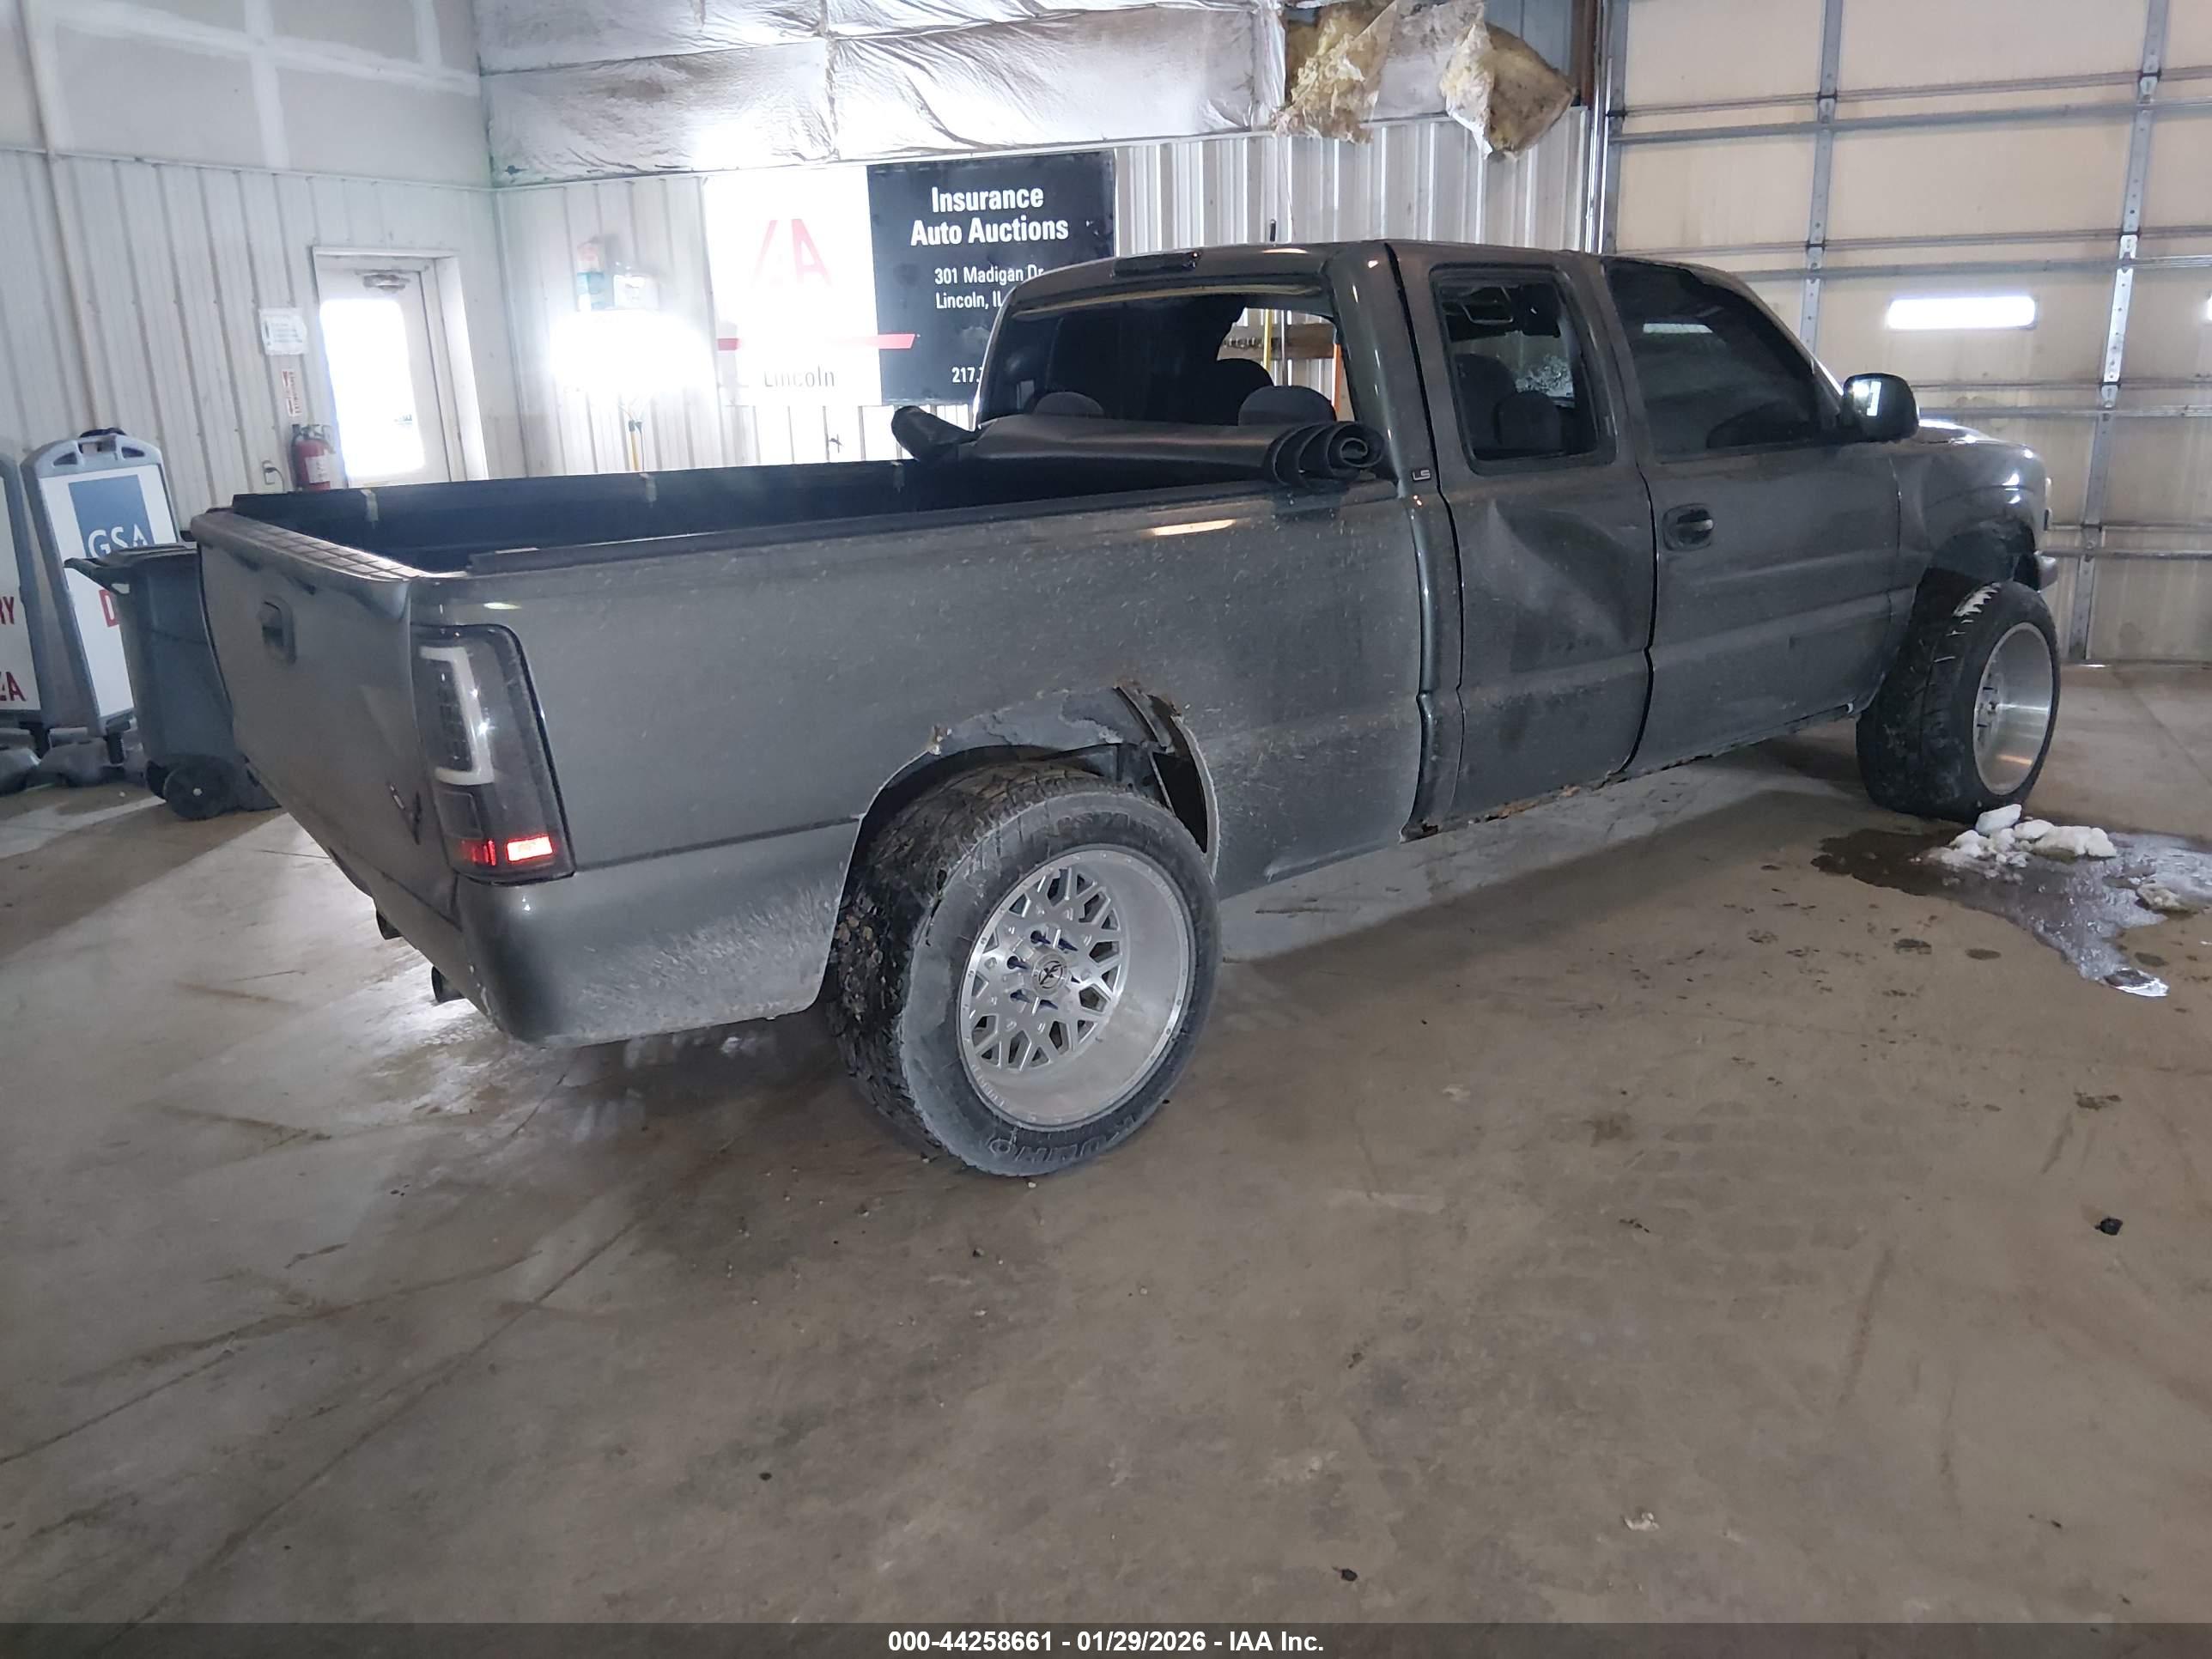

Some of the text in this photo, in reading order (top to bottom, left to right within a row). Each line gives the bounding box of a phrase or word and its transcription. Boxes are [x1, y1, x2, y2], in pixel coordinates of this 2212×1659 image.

[932, 186, 1044, 212] Insurance
[910, 215, 1069, 246] Auto Auctions
[934, 267, 958, 285] 301
[963, 264, 1024, 286] Madigan
[935, 290, 1004, 310] Lincoln, IL
[763, 363, 836, 388] Lincoln
[951, 366, 984, 384] 217.
[1412, 469, 1431, 481] LS
[88, 524, 149, 558] GSA
